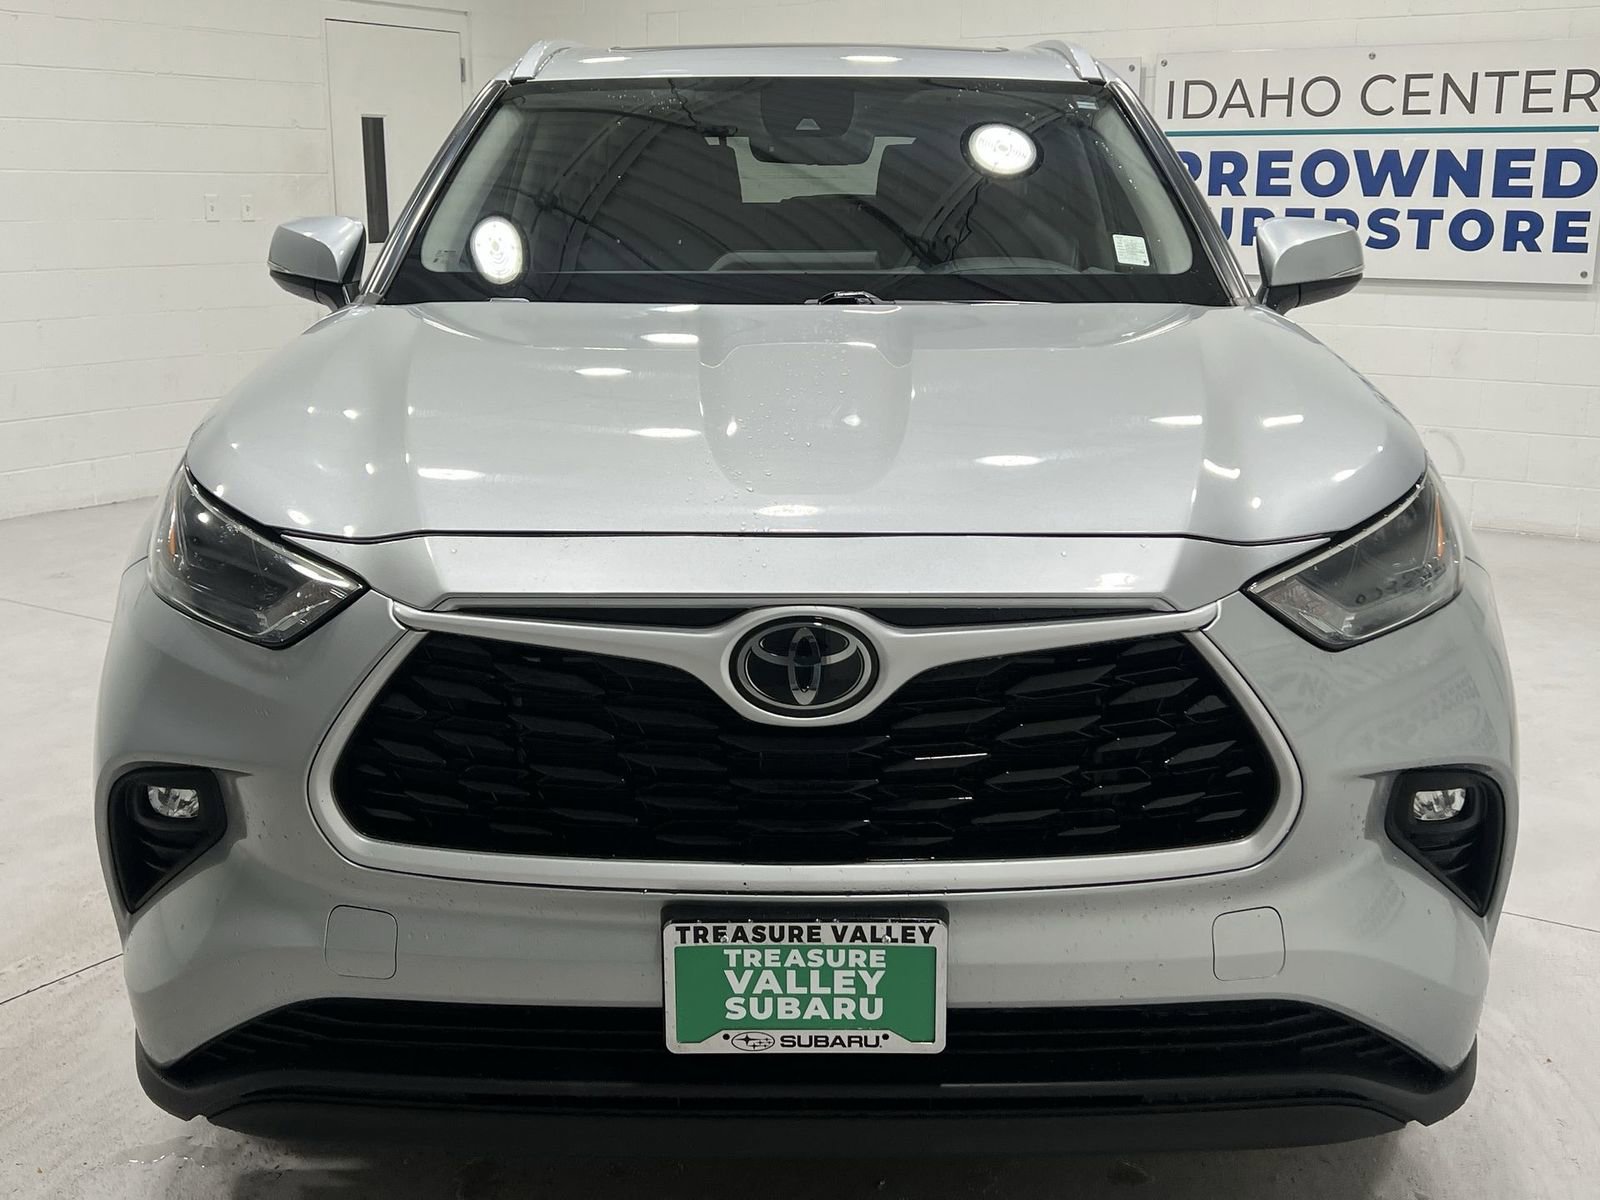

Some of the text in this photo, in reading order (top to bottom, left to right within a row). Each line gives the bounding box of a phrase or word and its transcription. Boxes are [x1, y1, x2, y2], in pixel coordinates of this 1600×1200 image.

[1166, 69, 1600, 119] IDAHO CENTER
[675, 925, 935, 944] TREASURE VALLEY
[723, 949, 886, 968] TREASURE
[723, 969, 886, 995] VALLEY
[724, 997, 884, 1020] SUBARU
[779, 1034, 880, 1048] SUBARU
